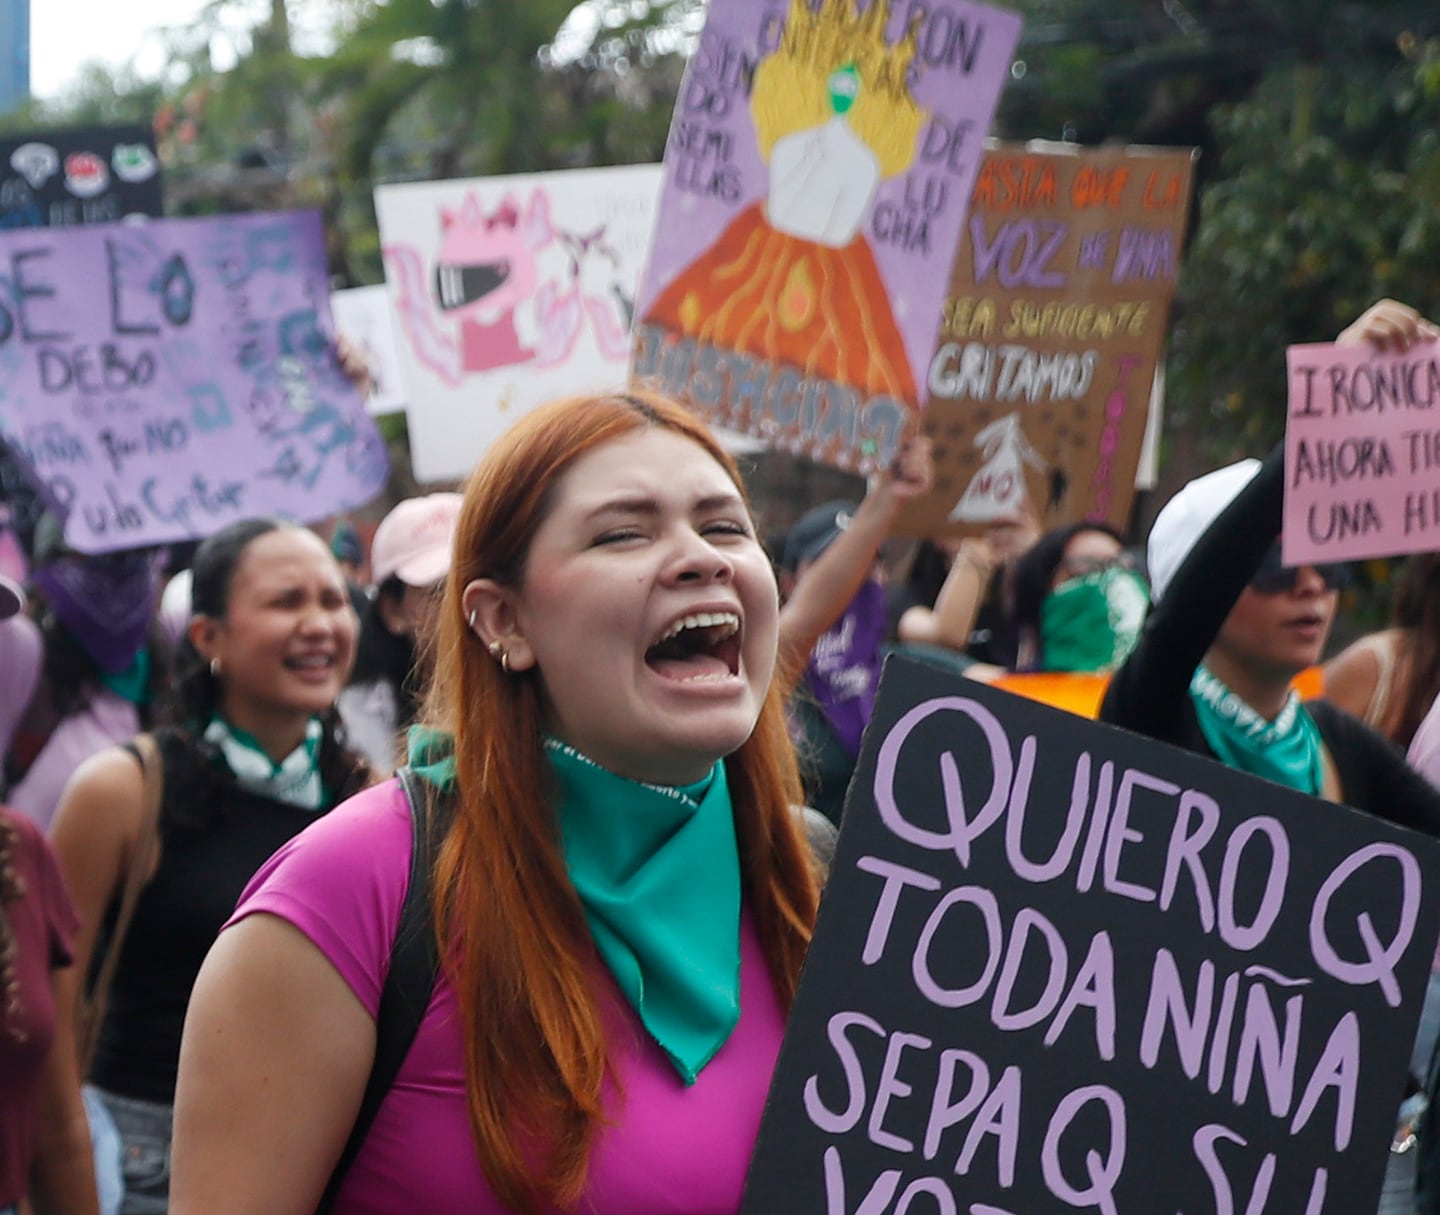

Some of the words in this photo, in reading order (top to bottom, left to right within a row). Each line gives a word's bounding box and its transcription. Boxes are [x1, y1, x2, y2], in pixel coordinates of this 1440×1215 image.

[104, 236, 195, 337] LO
[970, 214, 1070, 289] VOZ
[1111, 224, 1174, 285] UNA
[37, 340, 157, 395] DEBO
[928, 341, 1101, 405] GRITAMOS
[1292, 437, 1394, 490] AHORA
[1307, 498, 1382, 545] UNA
[873, 695, 1290, 951] QUIERO
[1309, 841, 1422, 1008] Q
[856, 855, 1117, 1061] TODA
[1138, 947, 1361, 1152] NIÑA
[803, 1010, 1022, 1188] SEPA
